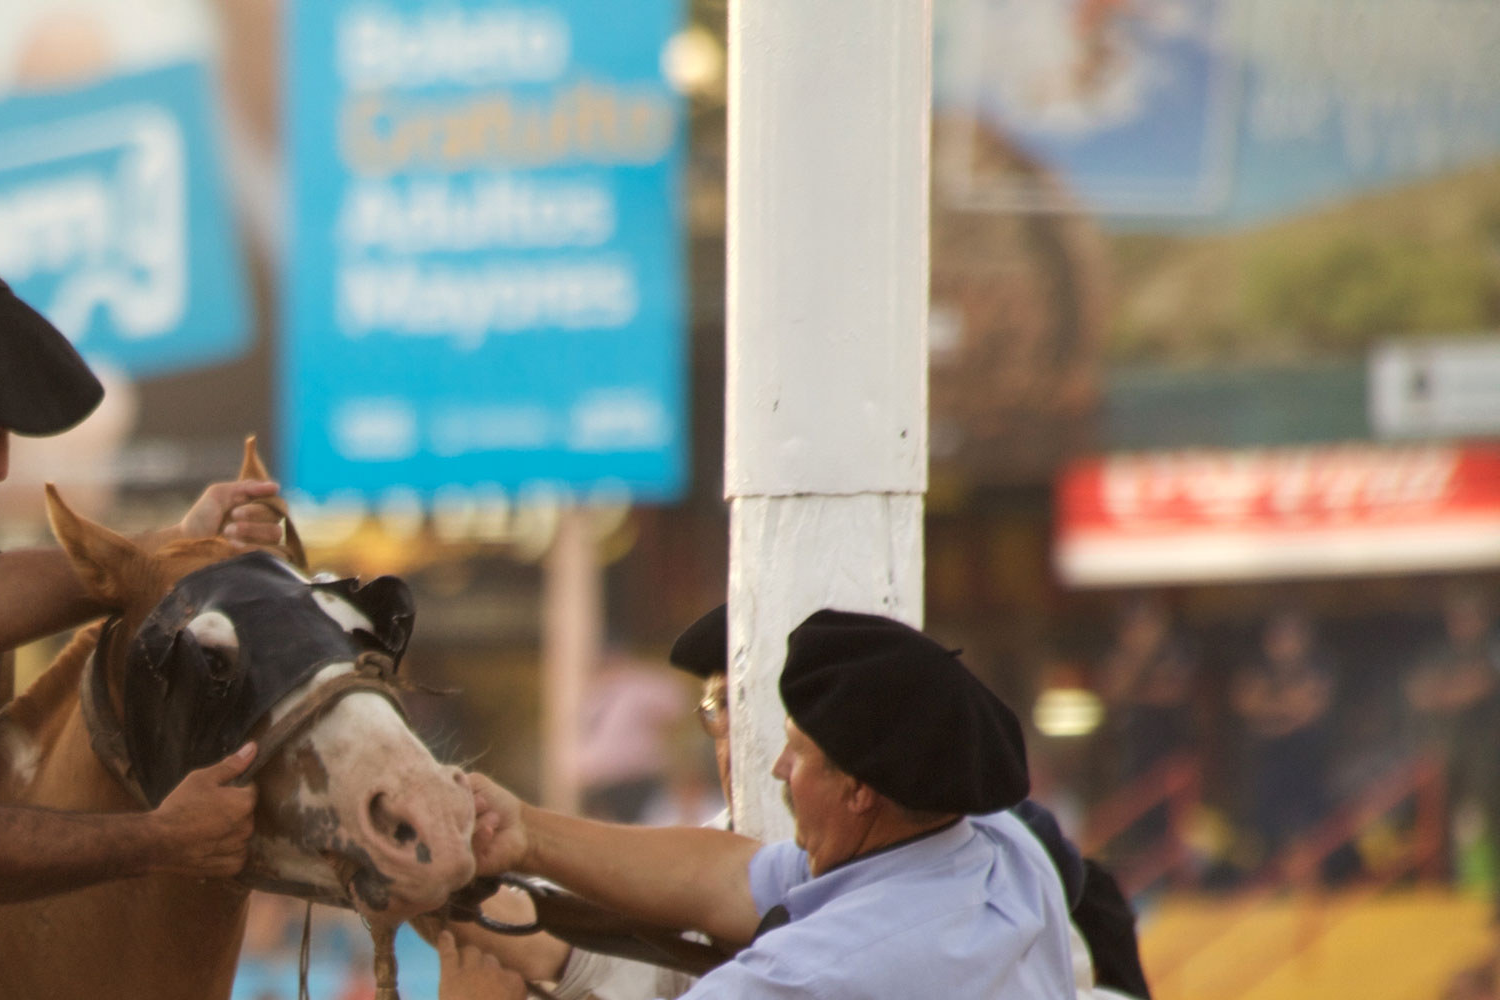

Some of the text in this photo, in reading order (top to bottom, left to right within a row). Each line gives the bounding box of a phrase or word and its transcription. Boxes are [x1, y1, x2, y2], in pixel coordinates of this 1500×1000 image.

[338, 11, 570, 86] Boleto
[338, 80, 674, 175] Gratuito
[337, 180, 614, 252] Adultos
[337, 260, 638, 350] Mayores
